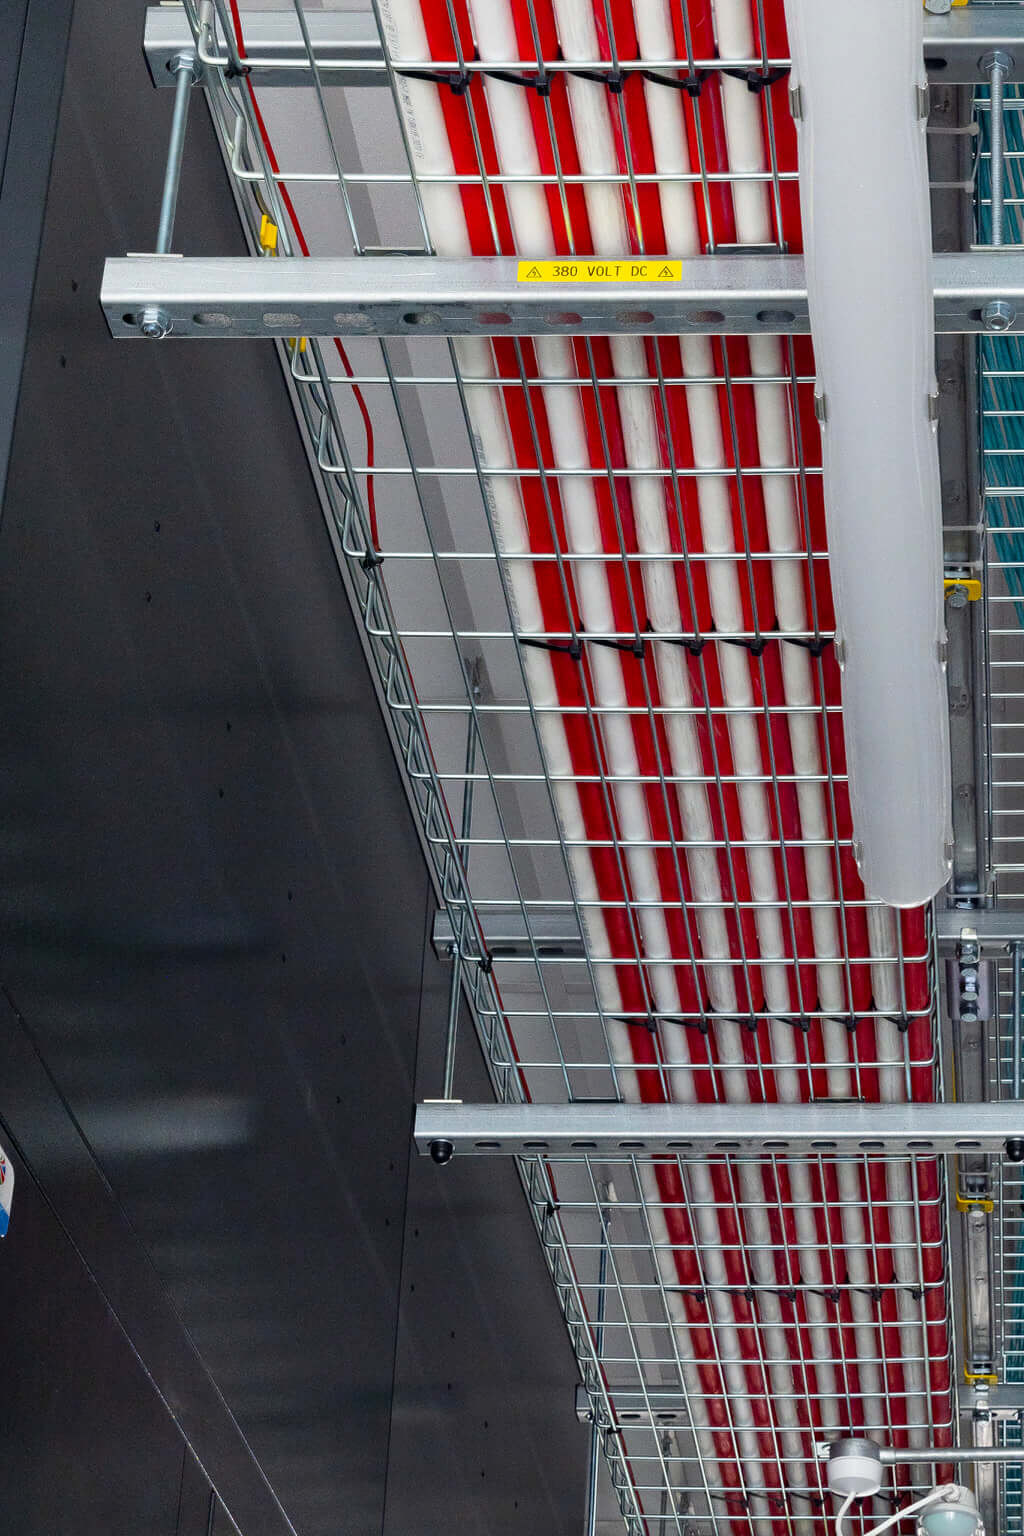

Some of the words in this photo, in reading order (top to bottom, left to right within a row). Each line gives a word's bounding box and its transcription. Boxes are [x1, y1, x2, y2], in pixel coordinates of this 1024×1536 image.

[552, 265, 578, 277] 380
[587, 265, 622, 277] VOLT
[631, 265, 648, 277] DC
